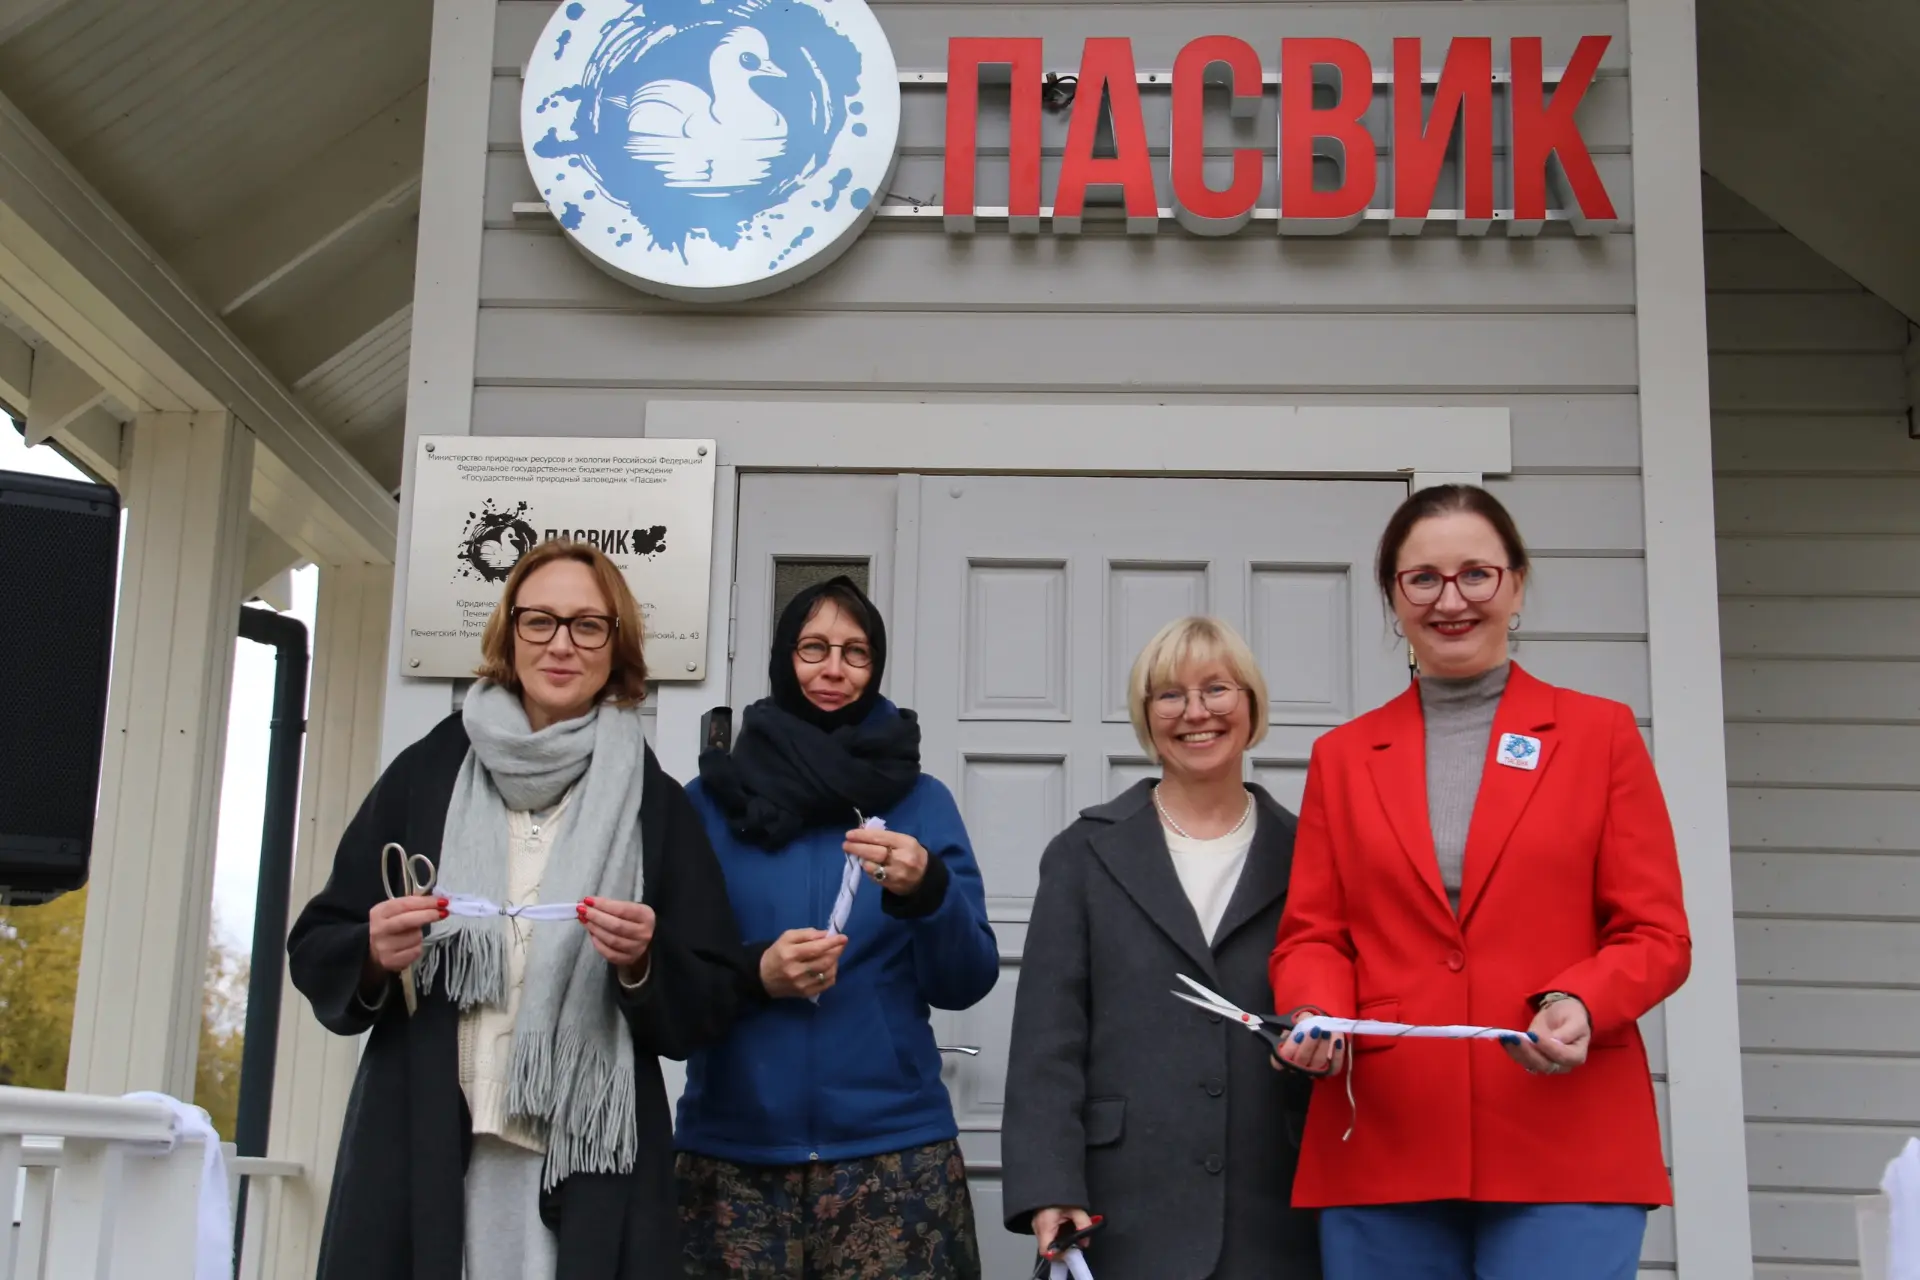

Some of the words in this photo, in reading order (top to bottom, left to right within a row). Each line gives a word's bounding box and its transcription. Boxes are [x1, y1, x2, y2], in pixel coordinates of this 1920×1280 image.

[942, 34, 1619, 228] ПАСВИК
[428, 453, 482, 462] Министерство
[485, 455, 528, 464] природных
[530, 456, 566, 464] ресурсов
[574, 456, 611, 464] экологии
[612, 456, 658, 464] Российской
[659, 456, 703, 465] Федерации
[457, 464, 509, 473] Федеральное
[511, 466, 577, 474] государственное
[578, 465, 624, 474] бюджетное
[625, 467, 674, 475] учреждение
[536, 474, 580, 484] природный
[582, 476, 628, 484] заповедник
[456, 599, 499, 609] Юридичес
[462, 619, 487, 629] Почто
[410, 628, 457, 638] Печенгский
[690, 631, 700, 640] 43
